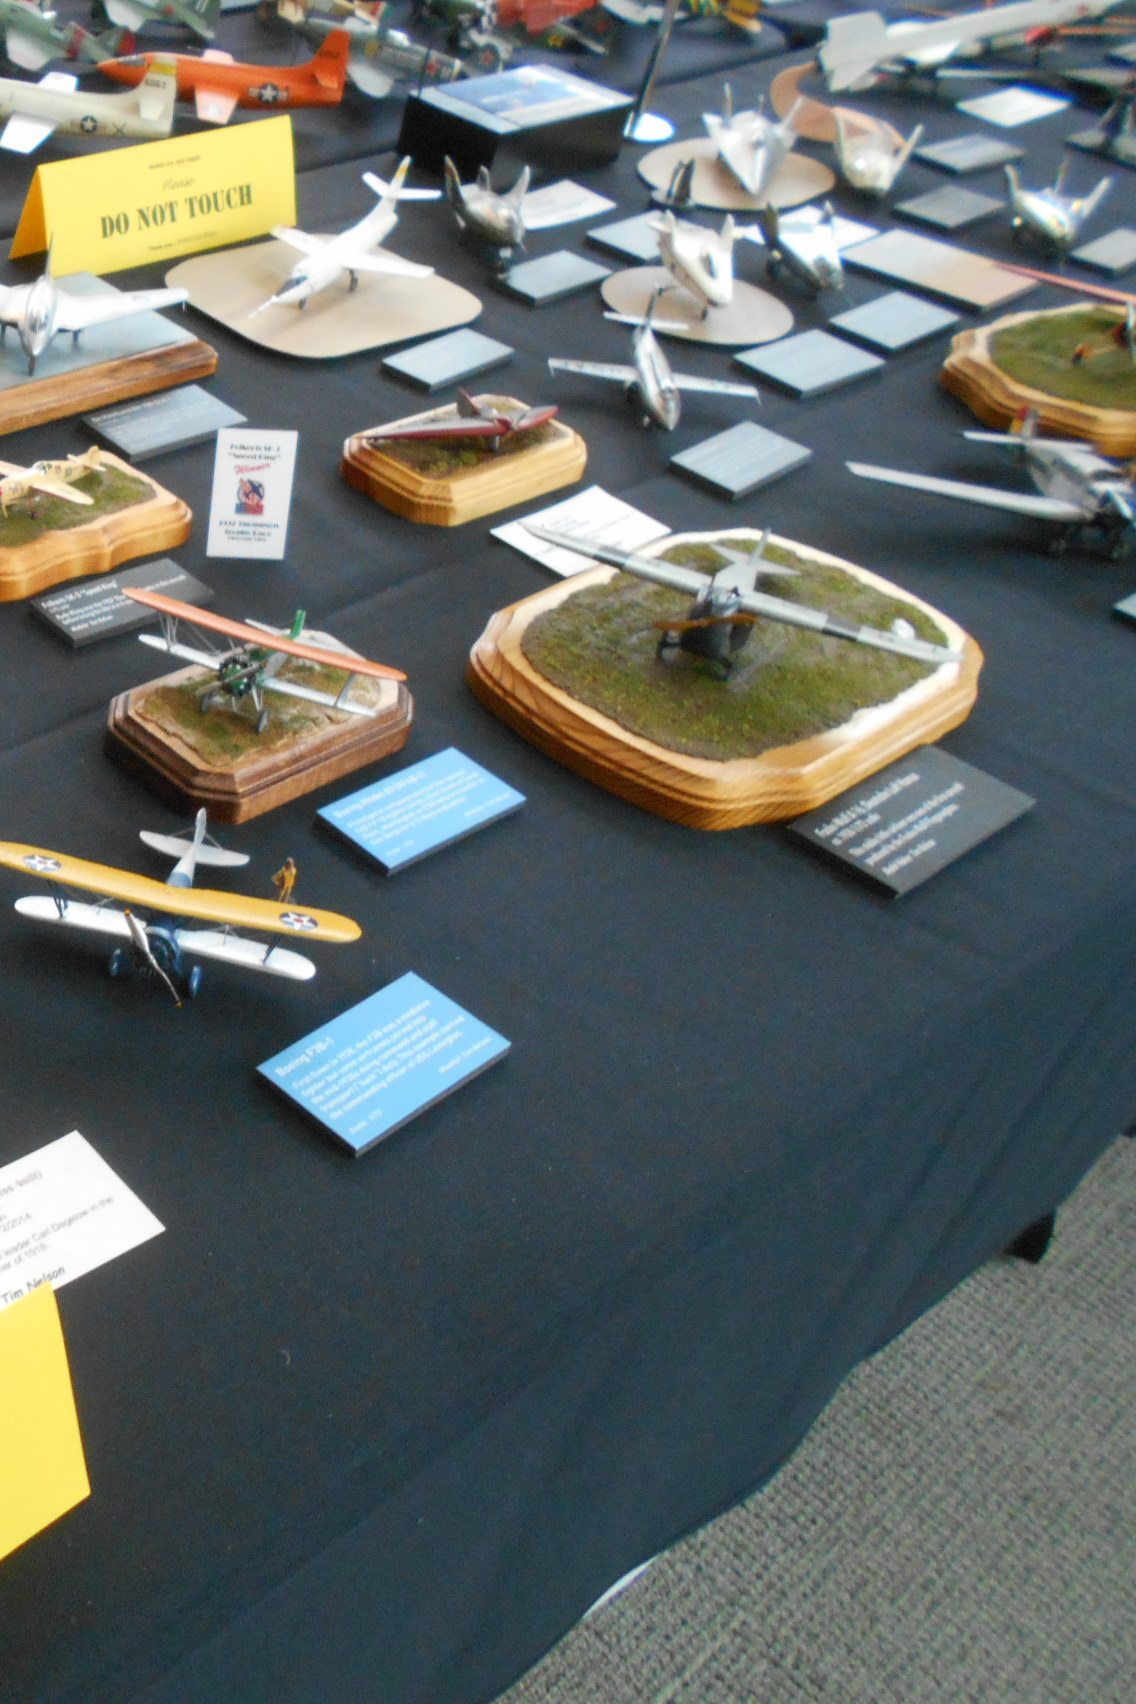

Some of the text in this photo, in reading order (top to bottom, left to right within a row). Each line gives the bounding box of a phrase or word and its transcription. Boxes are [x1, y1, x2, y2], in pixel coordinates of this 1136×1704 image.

[100, 183, 253, 239] DO NOT TOUCH
[1, 1267, 65, 1303] Tim Nelson
